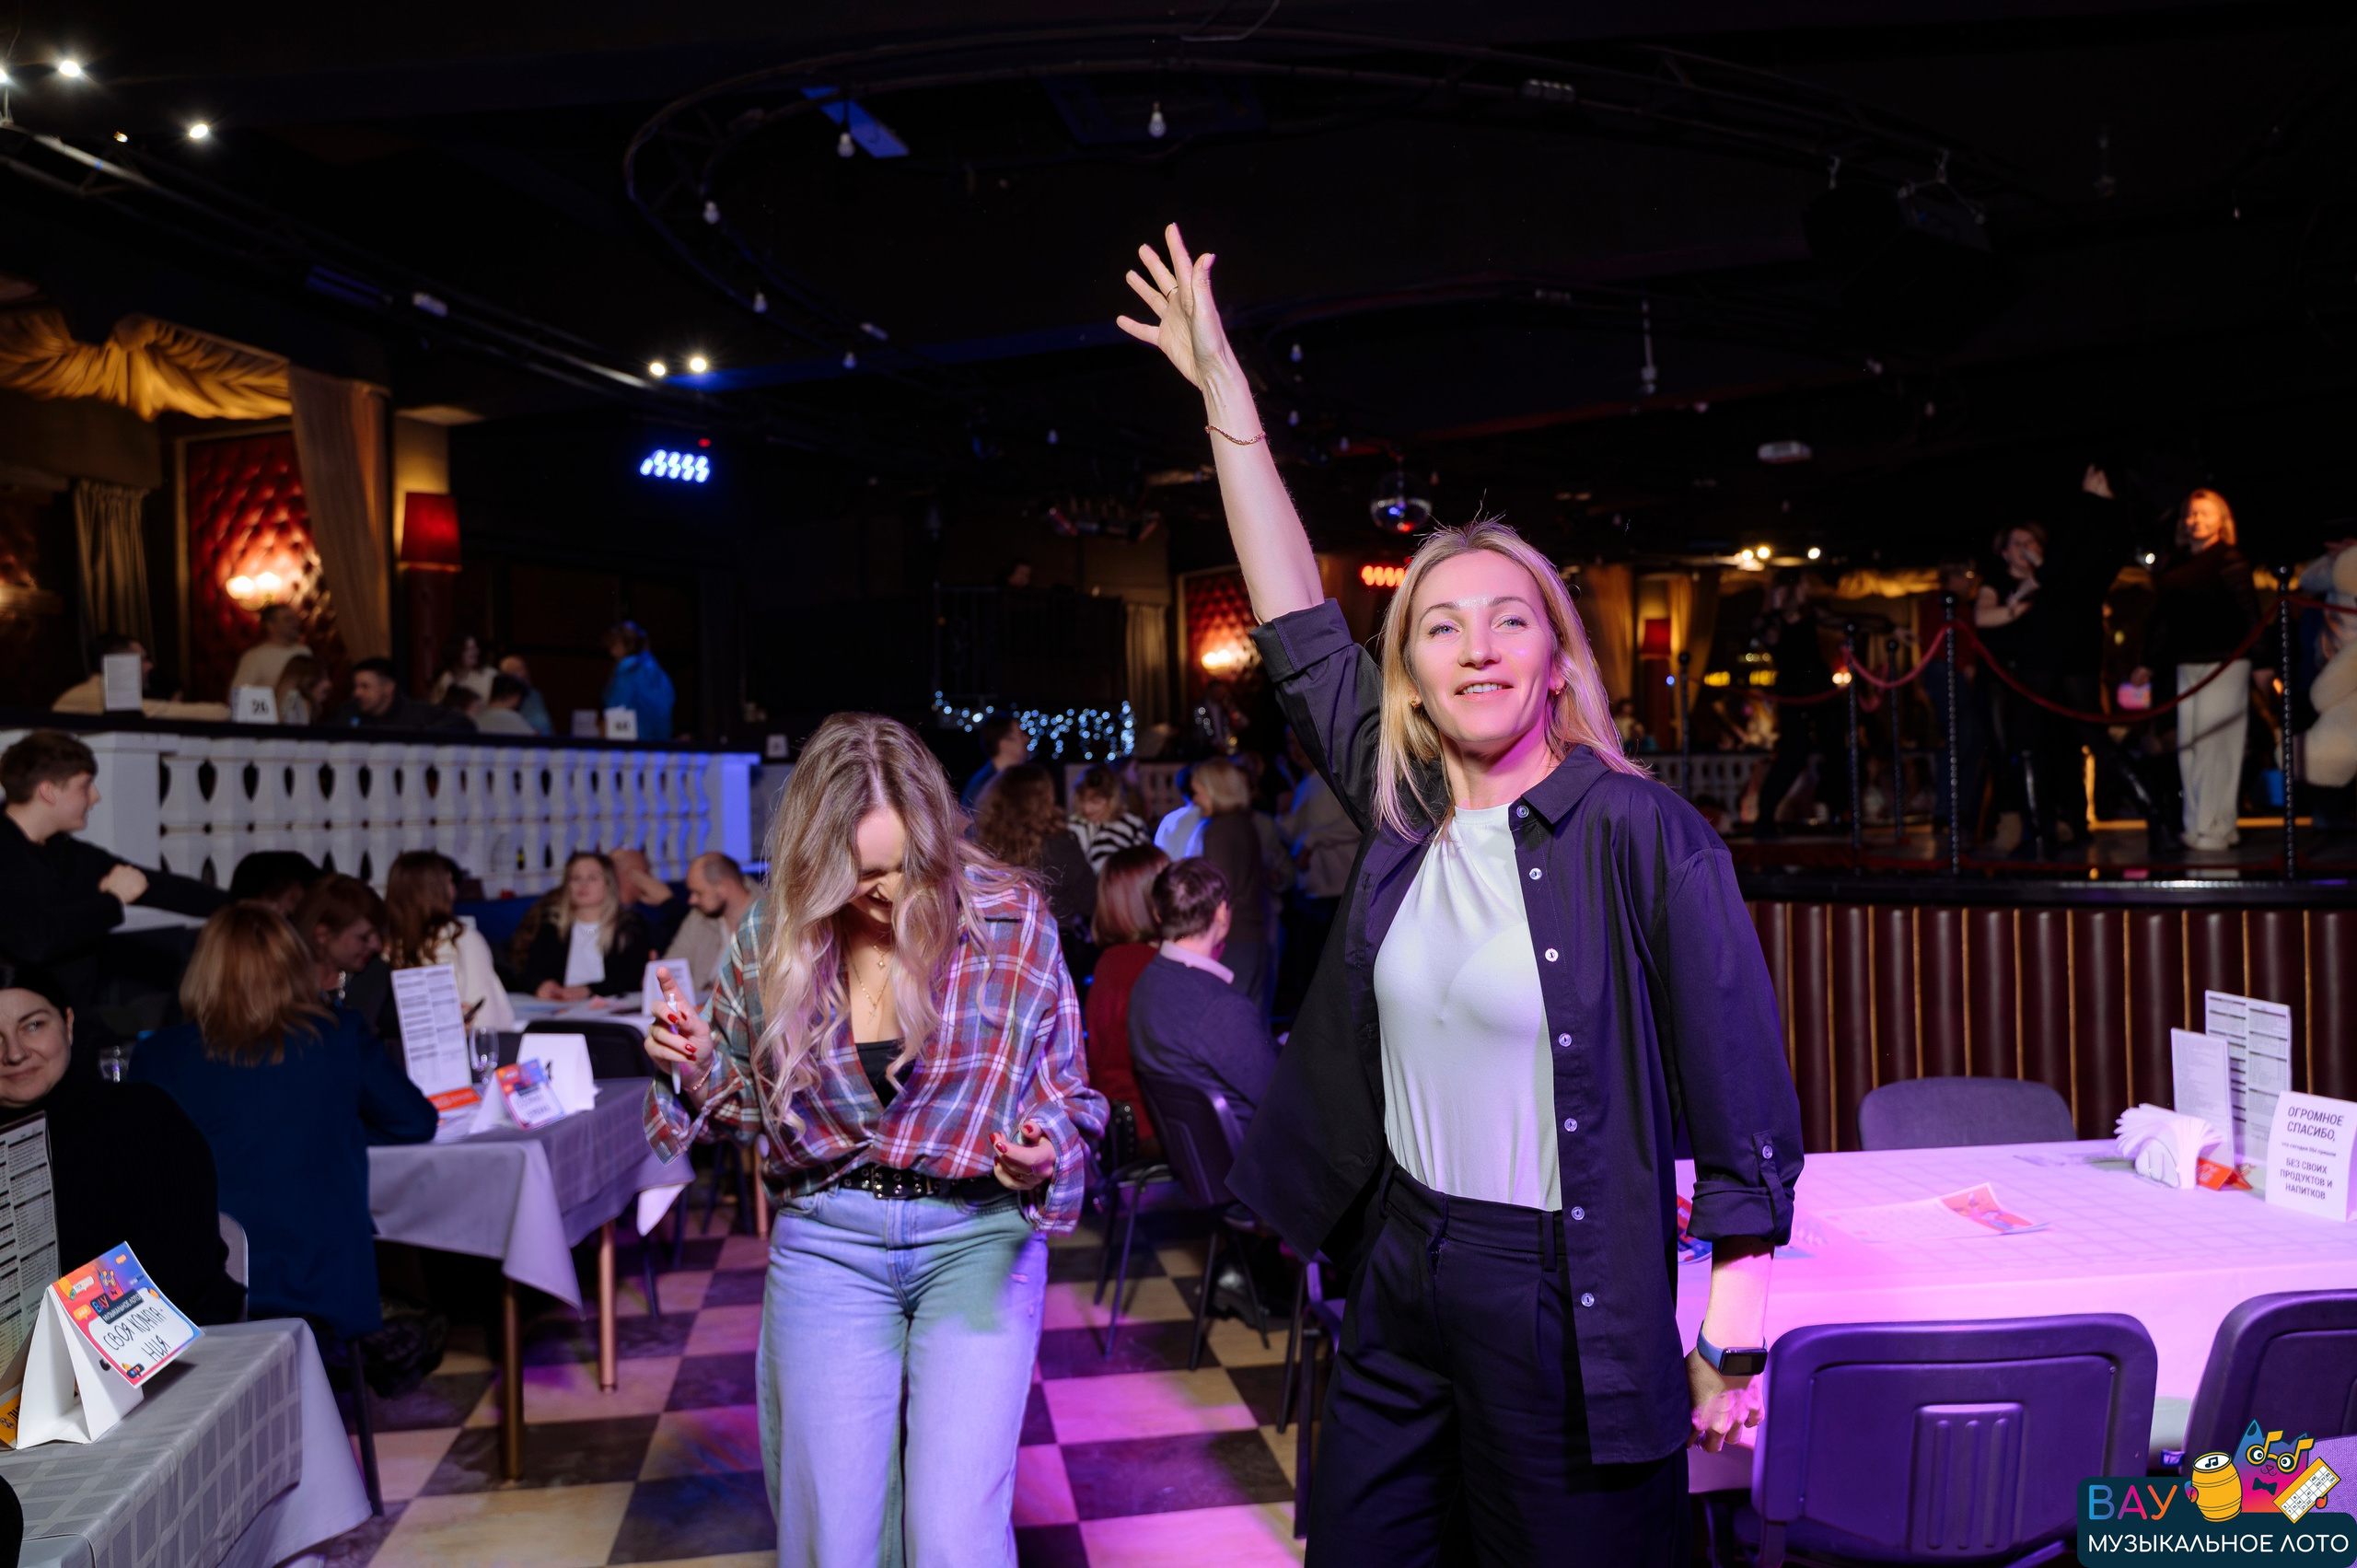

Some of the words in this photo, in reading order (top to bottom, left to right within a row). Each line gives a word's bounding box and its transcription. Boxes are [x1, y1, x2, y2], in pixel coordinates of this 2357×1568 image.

[2288, 1106, 2344, 1126] ОГРОМНОЕ
[2287, 1121, 2336, 1142] СПАСИБО,
[2286, 1157, 2300, 1168] БЕЗ
[2302, 1160, 2328, 1174] СВОИХ
[2280, 1168, 2325, 1187] ПРОДУКТОВ
[2327, 1179, 2333, 1189] И
[2285, 1183, 2326, 1200] НАПИТКОВ
[103, 1322, 135, 1351] СВОЯ
